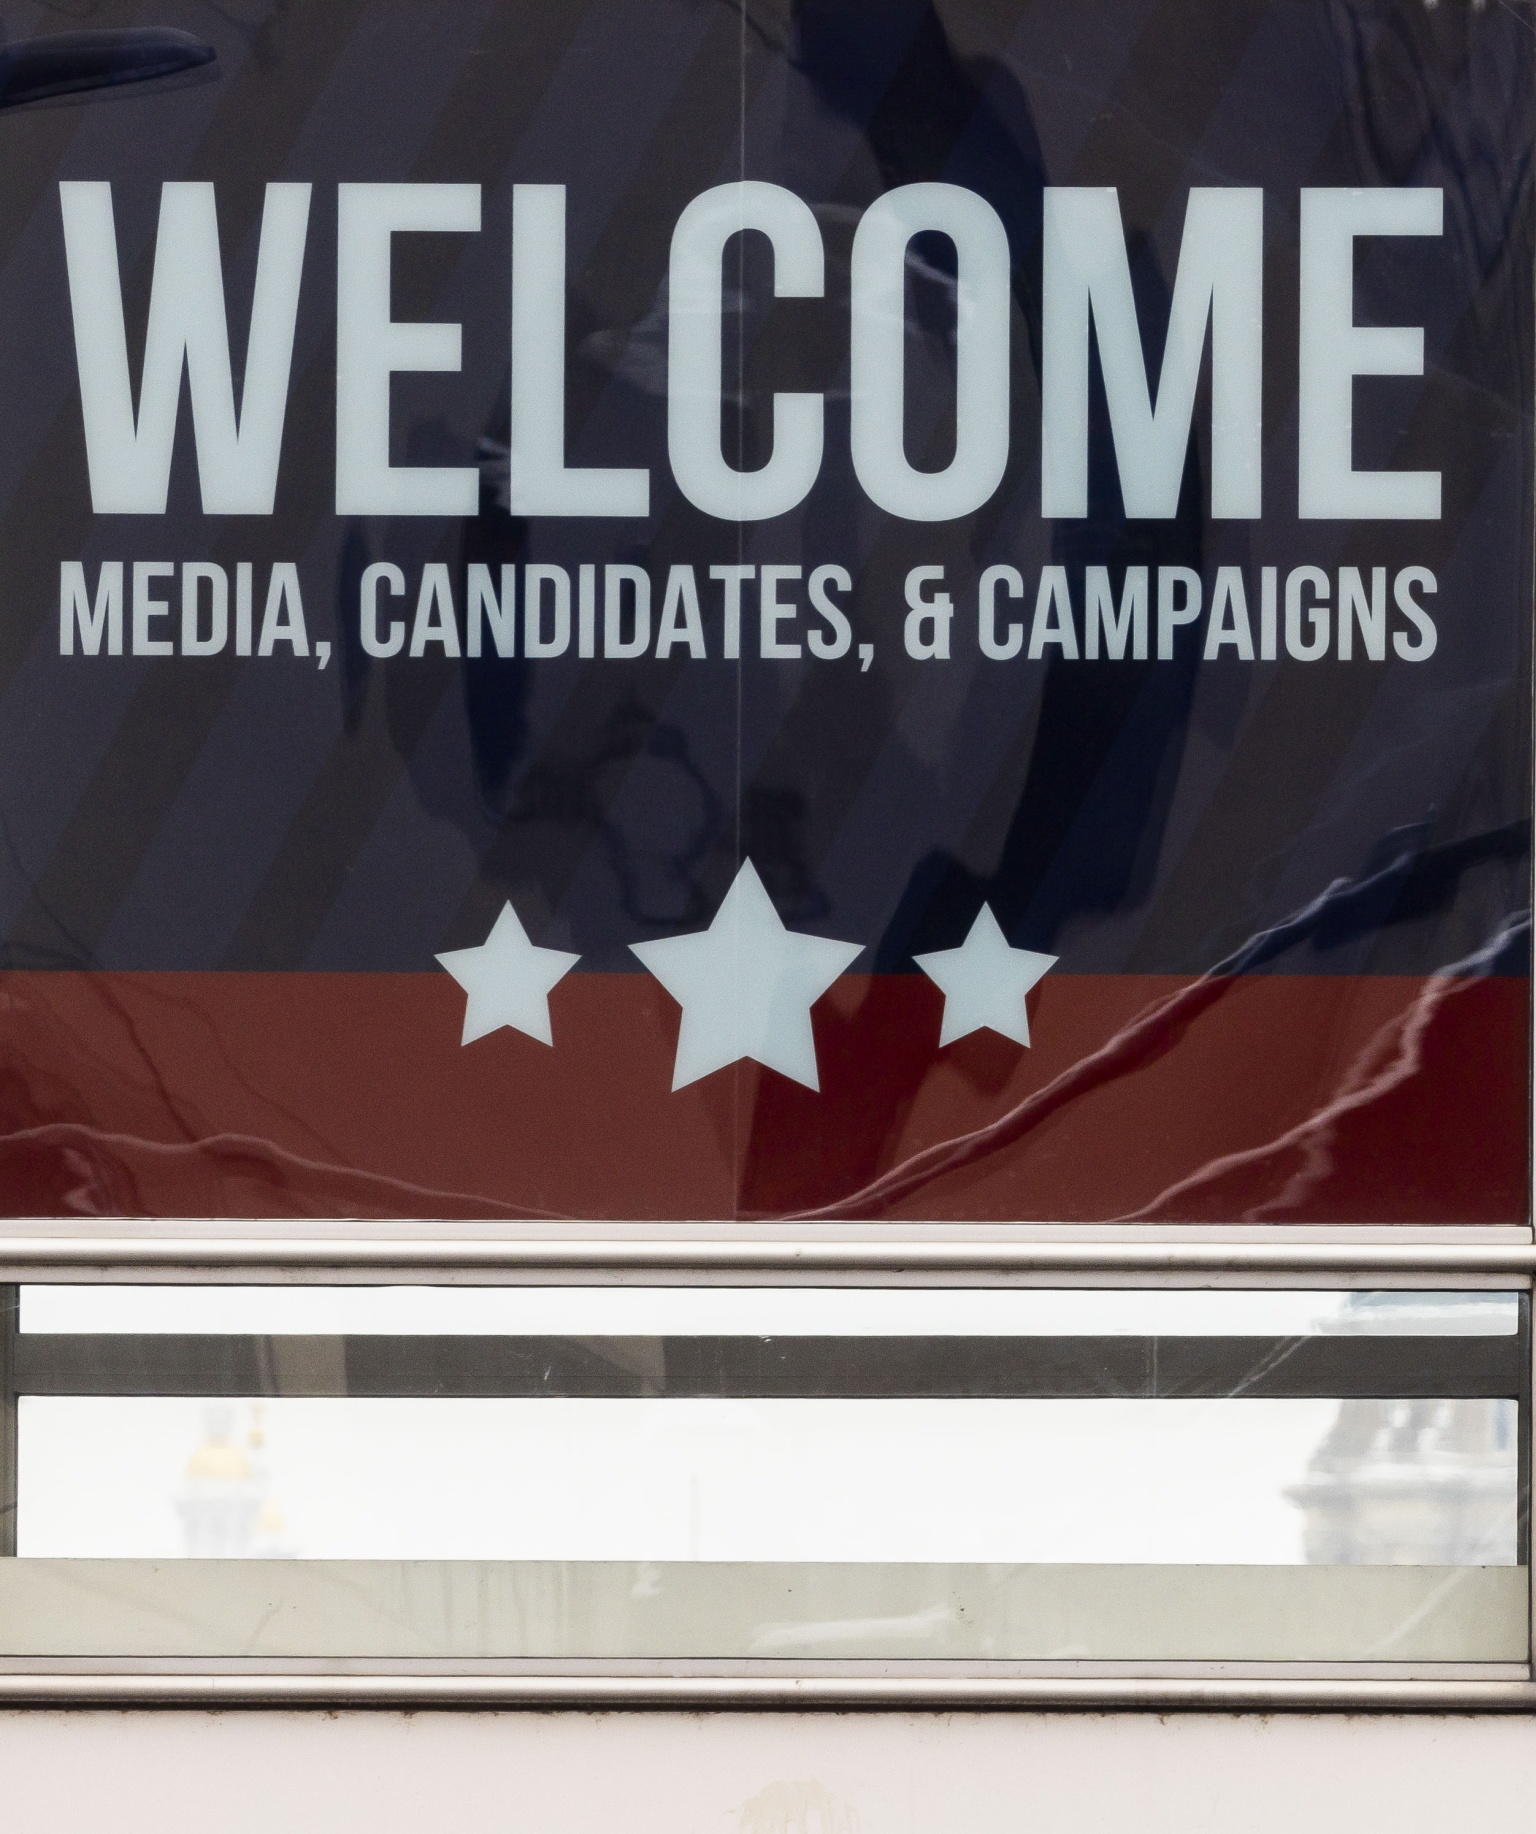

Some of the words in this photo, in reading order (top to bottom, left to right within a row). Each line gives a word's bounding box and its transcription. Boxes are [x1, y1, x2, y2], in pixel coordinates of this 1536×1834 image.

[59, 181, 1444, 521] WELCOME
[59, 561, 331, 670] MEDIA,
[360, 563, 875, 672] CANDIDATES,
[904, 565, 954, 660] &
[978, 565, 1438, 661] CAMPAIGNS
